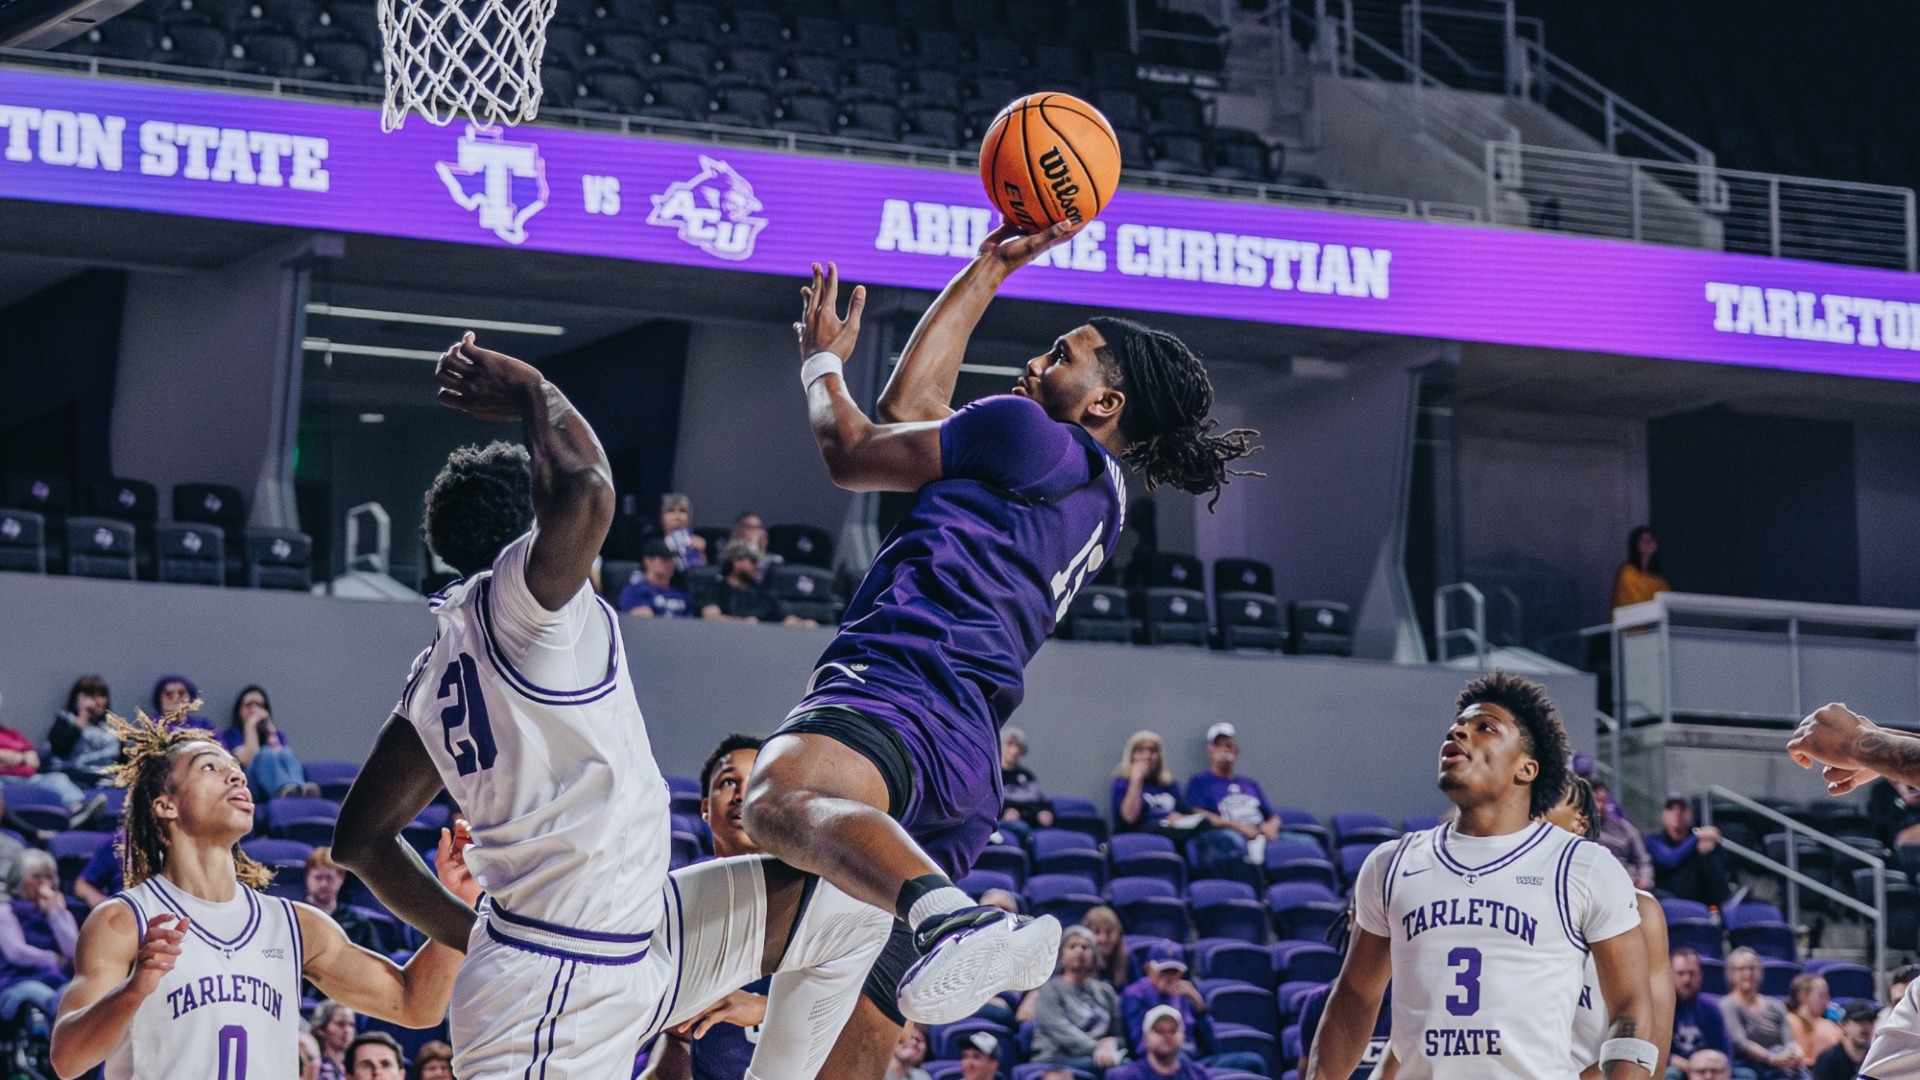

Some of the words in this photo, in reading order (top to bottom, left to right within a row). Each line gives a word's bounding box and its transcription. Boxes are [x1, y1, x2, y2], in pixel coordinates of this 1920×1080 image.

[0, 104, 126, 172] TON
[140, 120, 330, 193] STATE
[582, 174, 621, 216] VS
[1039, 145, 1084, 226] Wilson
[659, 188, 752, 253] ACU
[875, 199, 1107, 273] ABILE
[1116, 223, 1393, 300] CHRISTIAN
[1705, 281, 1920, 351] TARLETO
[437, 652, 498, 777] 21
[1515, 875, 1544, 886] WAC
[1402, 898, 1538, 947] TARLETON
[166, 974, 283, 1022] TARLETON
[1446, 946, 1482, 1017] 3
[218, 1024, 248, 1080] 0
[1425, 1029, 1502, 1057] STATE
